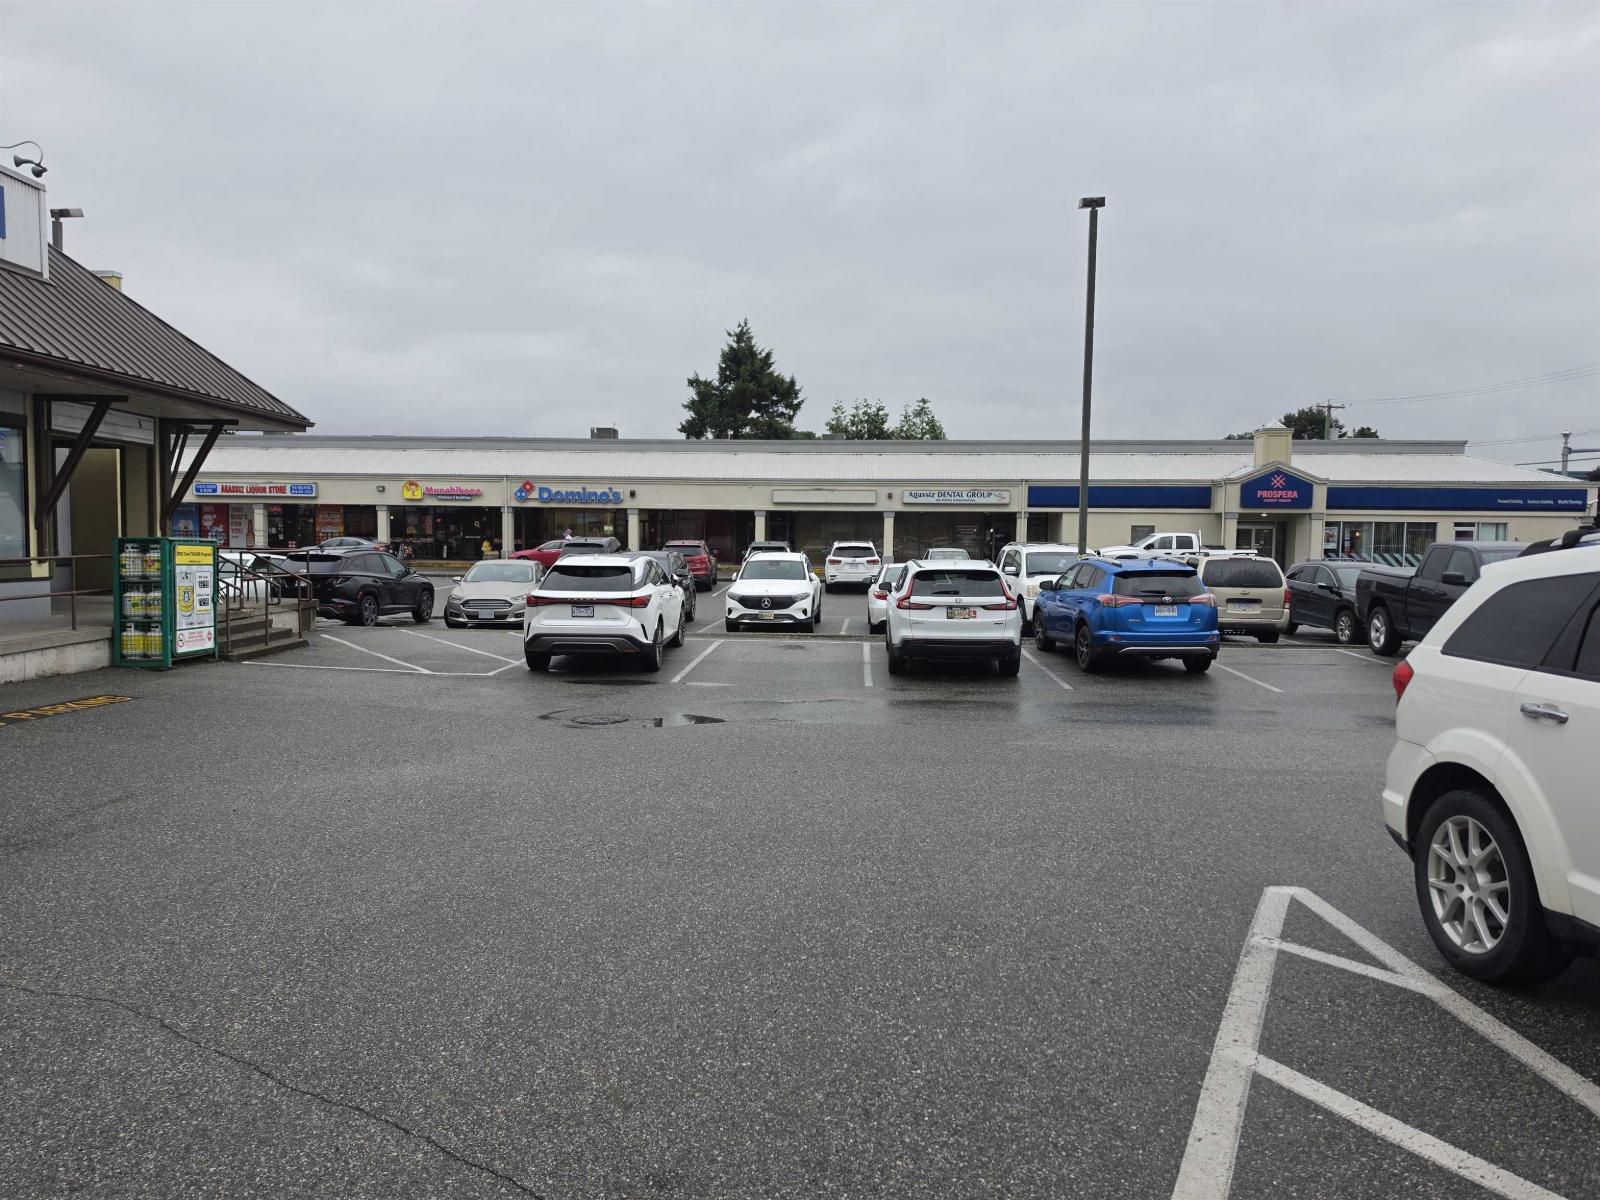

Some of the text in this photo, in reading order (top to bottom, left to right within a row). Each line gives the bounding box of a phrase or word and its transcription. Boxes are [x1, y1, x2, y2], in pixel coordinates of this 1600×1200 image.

[221, 484, 244, 494] AGASSIZ
[245, 485, 267, 494] LIQUOR
[268, 485, 287, 494] STORE
[538, 486, 623, 503] Domino's
[908, 491, 935, 499] Agassiz
[1257, 490, 1298, 498] PROSPERA
